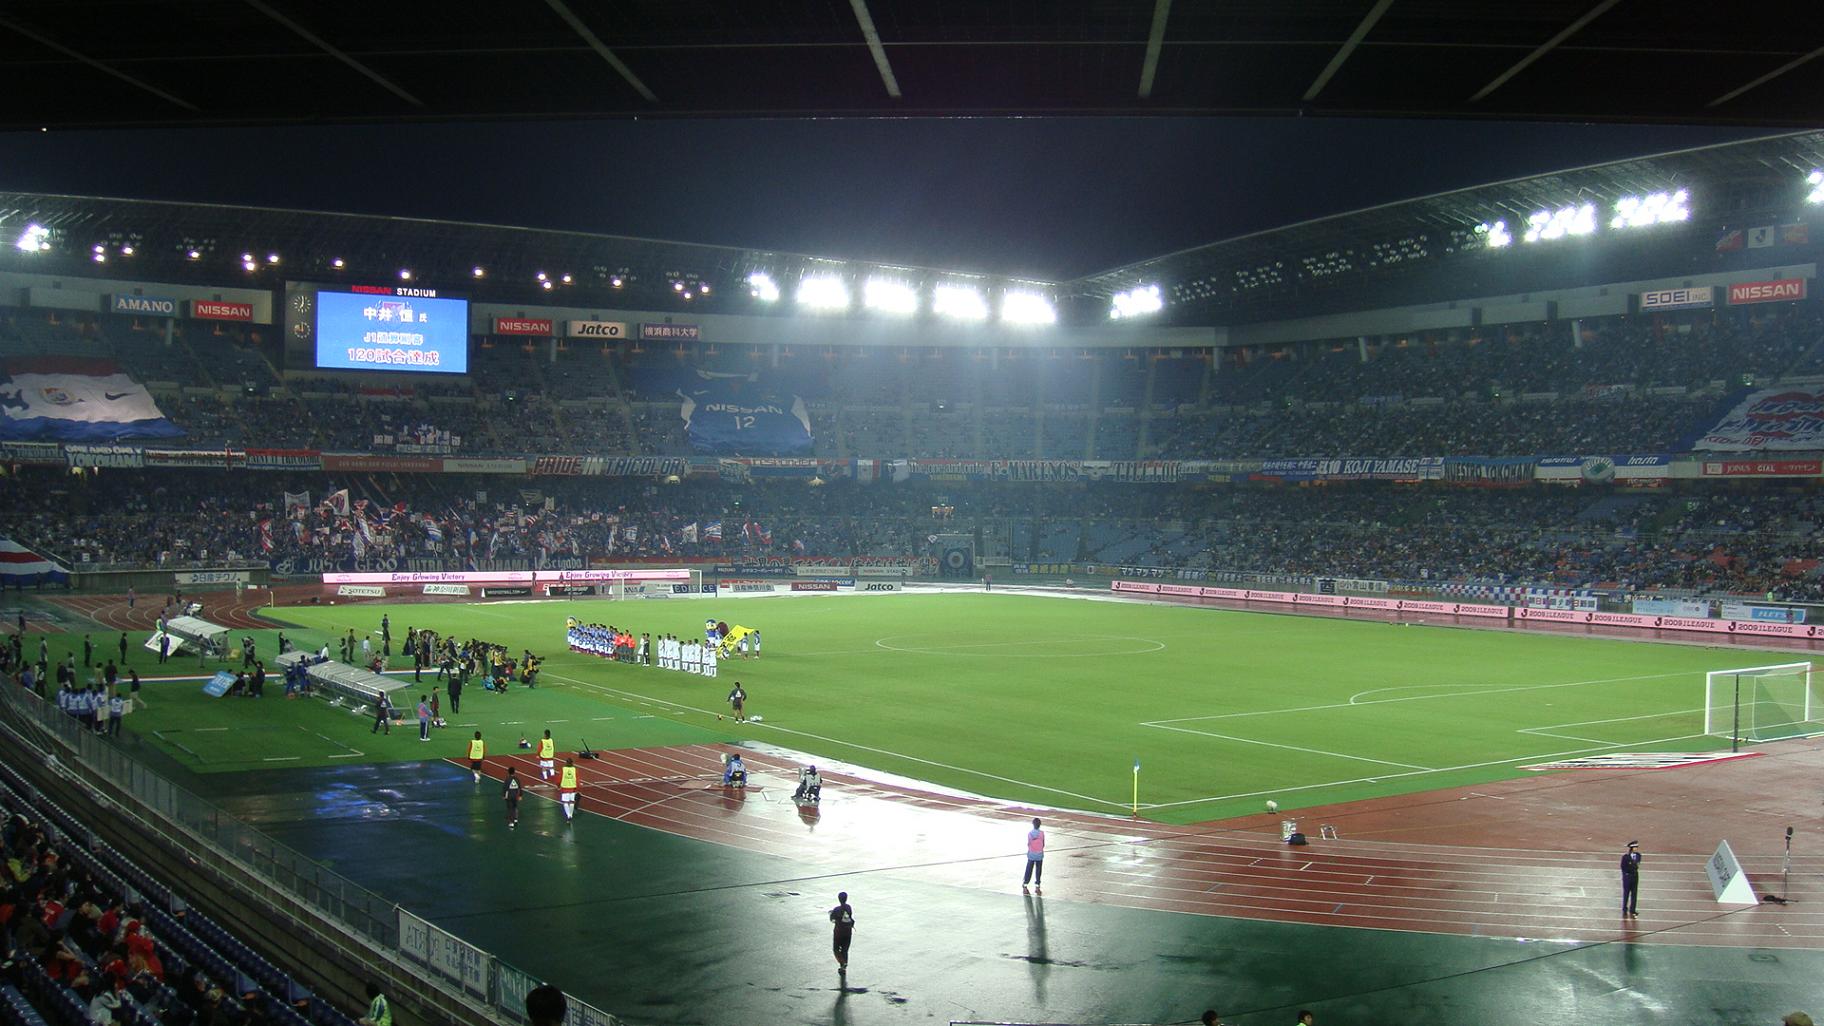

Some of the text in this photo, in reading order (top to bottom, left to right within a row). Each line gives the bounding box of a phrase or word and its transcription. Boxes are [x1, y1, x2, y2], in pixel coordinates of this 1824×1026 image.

[352, 285, 436, 298] NISSAN STADIUM
[1646, 290, 1690, 305] SOEI
[1732, 283, 1799, 300] NISSAN
[117, 298, 173, 313] AMANO
[198, 304, 250, 317] NISSAN
[500, 321, 549, 333] NISSAN
[577, 323, 619, 336] Jatco
[705, 403, 784, 415] NISSAN
[735, 415, 756, 430] 12
[67, 453, 144, 467] YOKOHAMA
[534, 456, 583, 476] PRIDE
[583, 456, 604, 475] IN
[1343, 460, 1372, 474] KOJI
[1373, 459, 1420, 474] YAMASE
[391, 573, 465, 582] Enjoy Growing Victory
[584, 571, 610, 579] Growing
[674, 585, 716, 593] EDIFCE
[864, 582, 894, 591] Jatco
[1738, 623, 1758, 631] 2009
